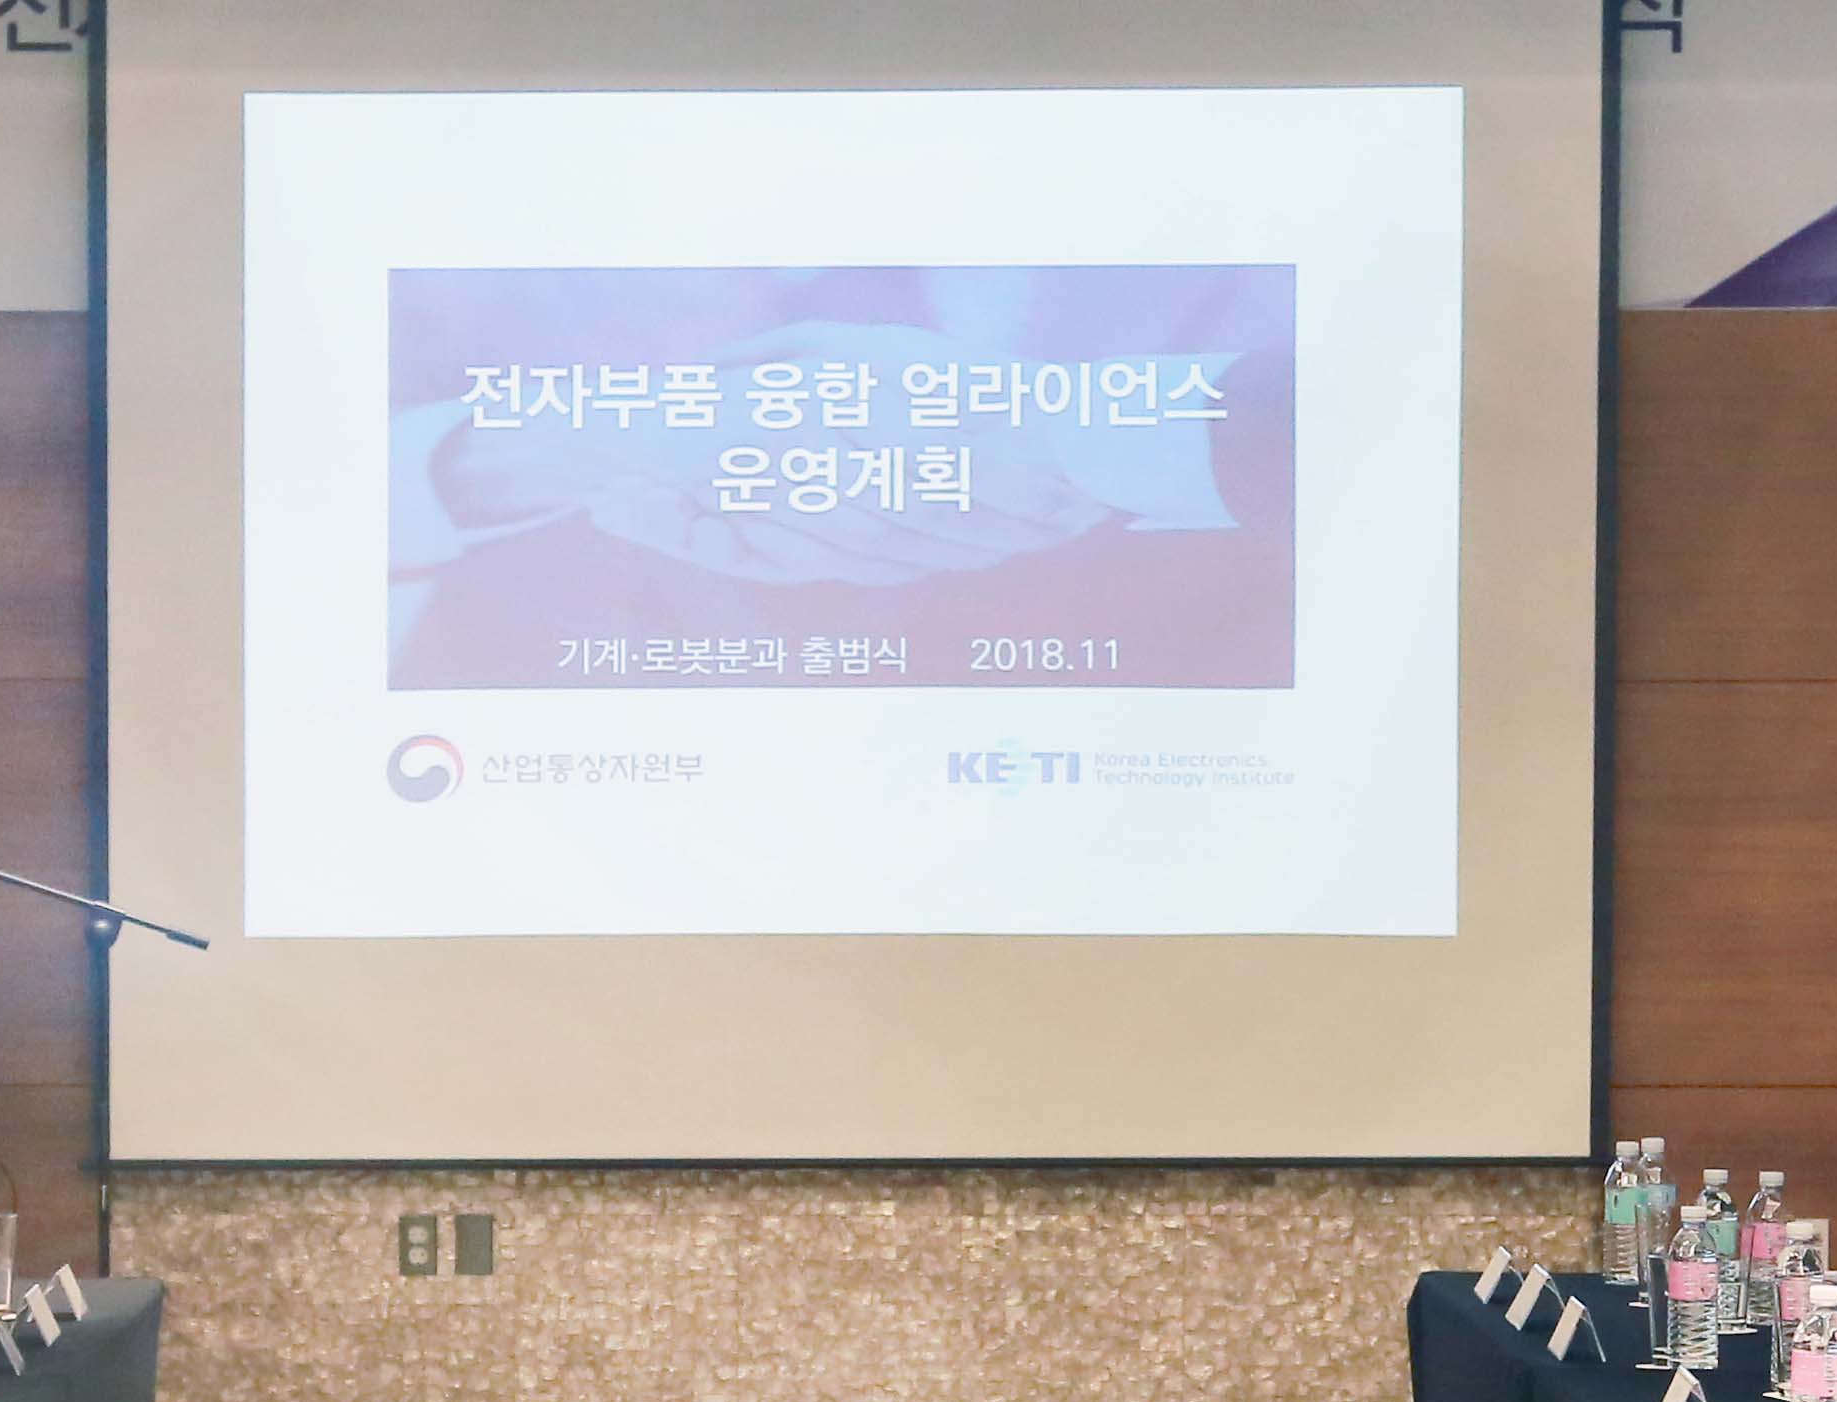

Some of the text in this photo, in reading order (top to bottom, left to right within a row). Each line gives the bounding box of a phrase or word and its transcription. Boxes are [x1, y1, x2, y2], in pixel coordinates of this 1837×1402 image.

[460, 362, 1228, 429] 전자부품 융합 얼라이언스
[712, 445, 972, 513] 운영계획
[800, 637, 908, 675] 출범식
[970, 638, 1120, 671] 2018.11
[483, 753, 703, 784] 산업통상자원부
[1094, 751, 1268, 768] Korea Electronics
[1094, 769, 1295, 788] Technology Institute
